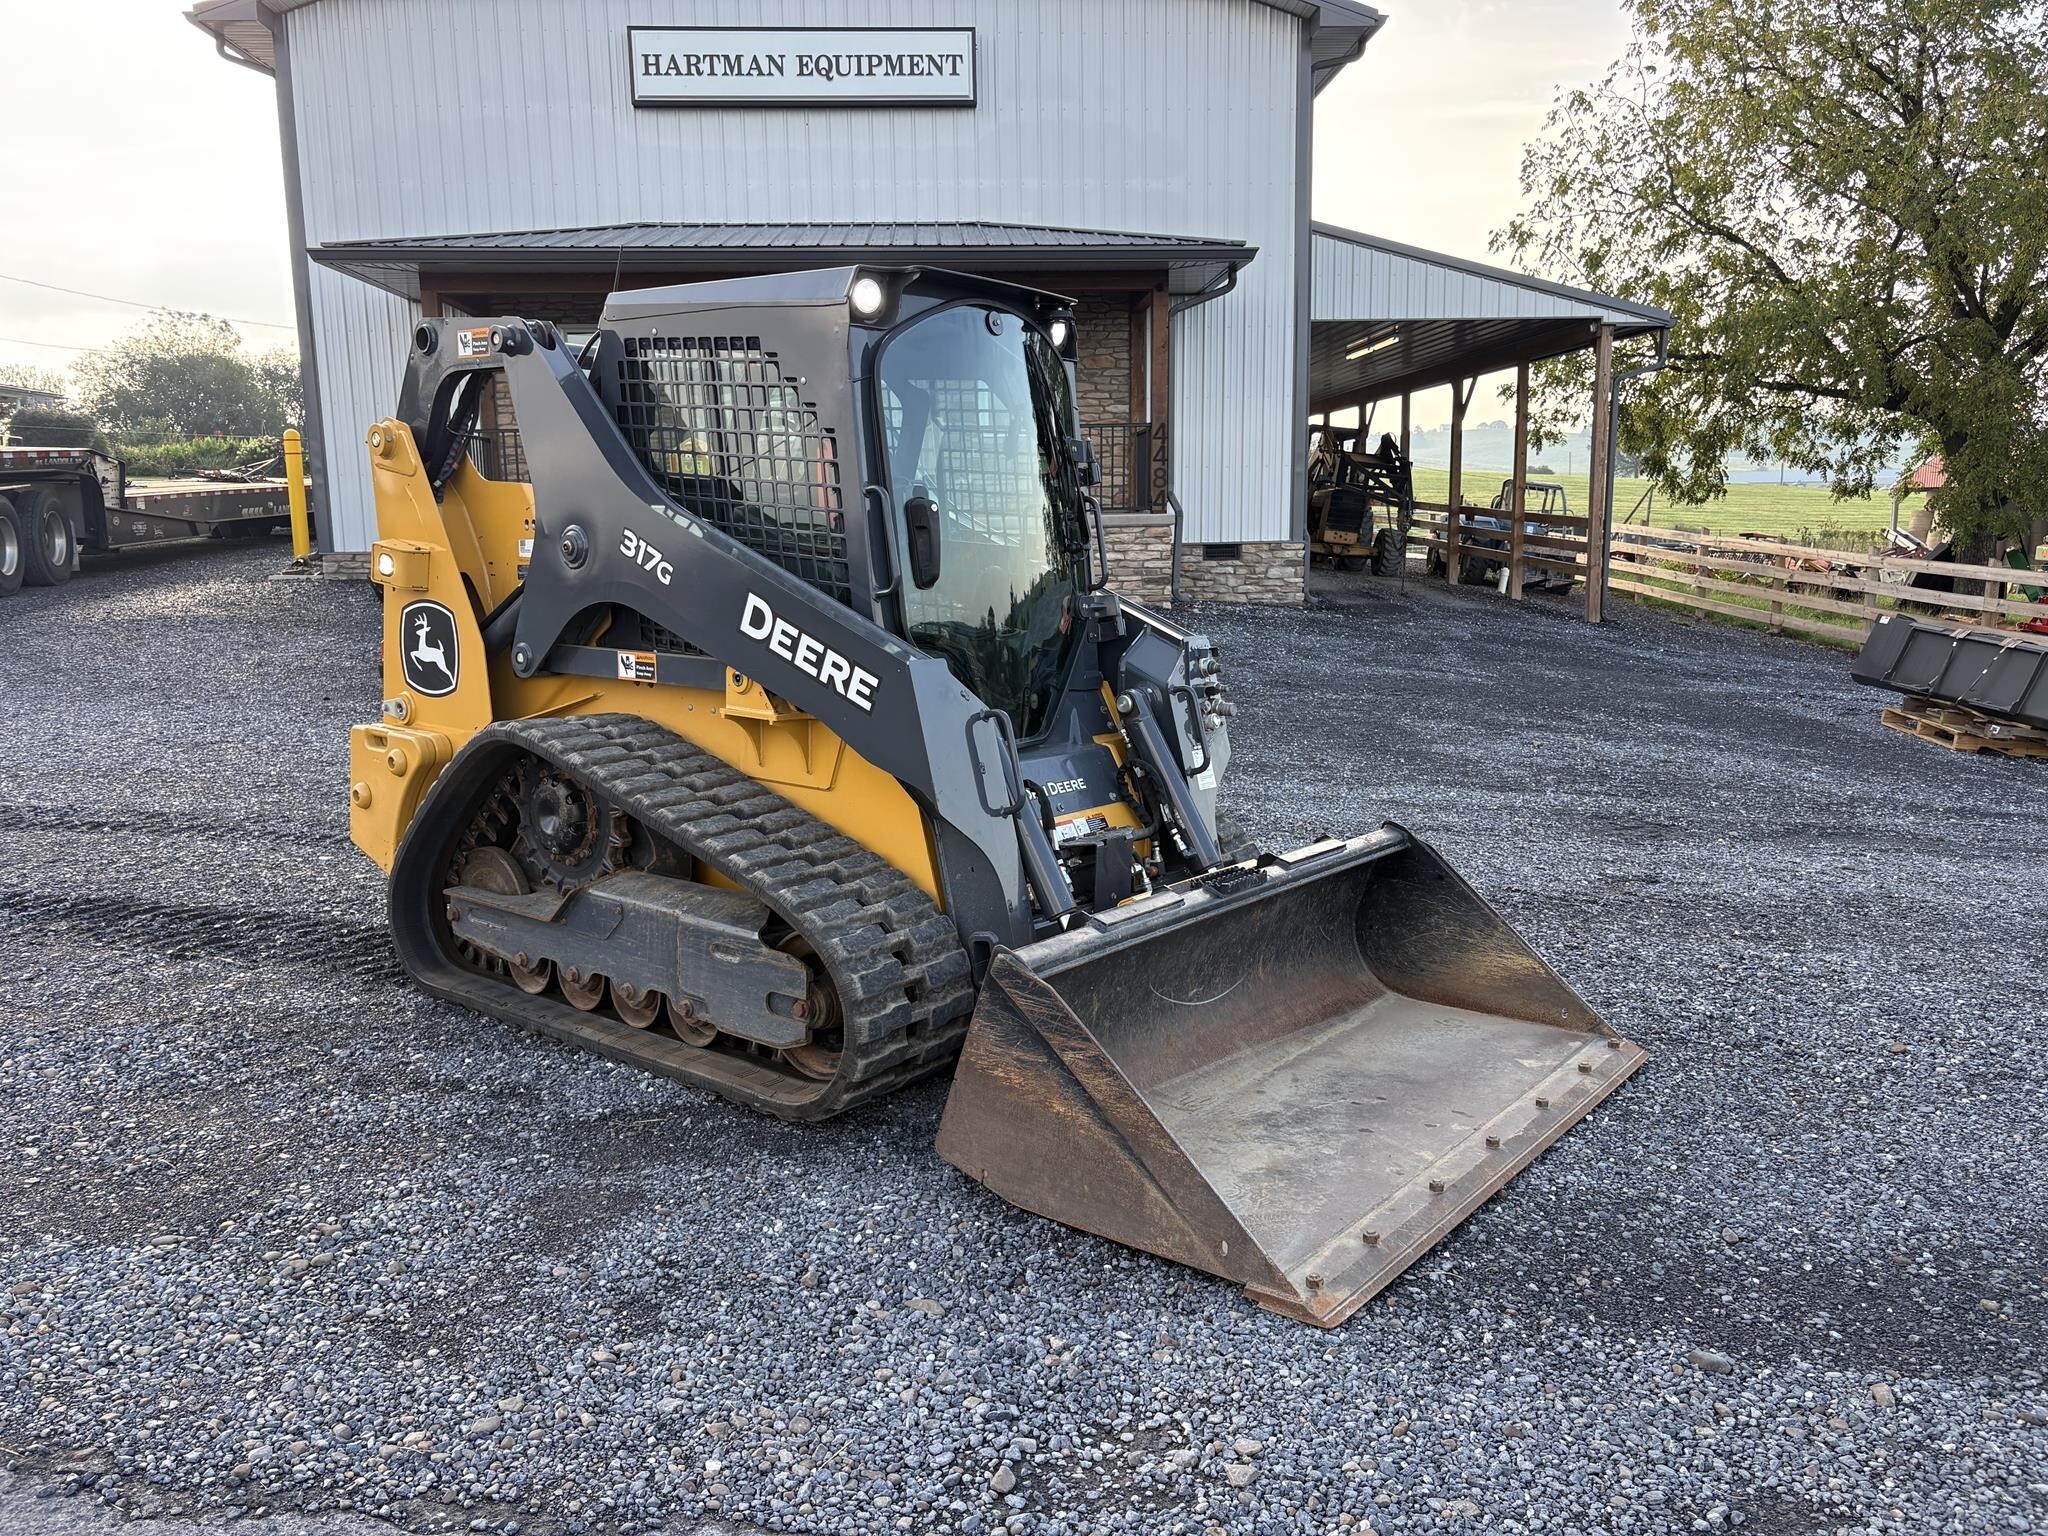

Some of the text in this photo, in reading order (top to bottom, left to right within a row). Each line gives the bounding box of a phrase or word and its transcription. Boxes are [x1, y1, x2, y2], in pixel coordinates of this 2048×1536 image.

[641, 53, 964, 82] HARTMAN EQUIPMENT
[1153, 422, 1168, 511] 4484
[618, 527, 675, 586] 317G
[739, 591, 880, 712] DEERE
[1046, 777, 1087, 796] DEERE
